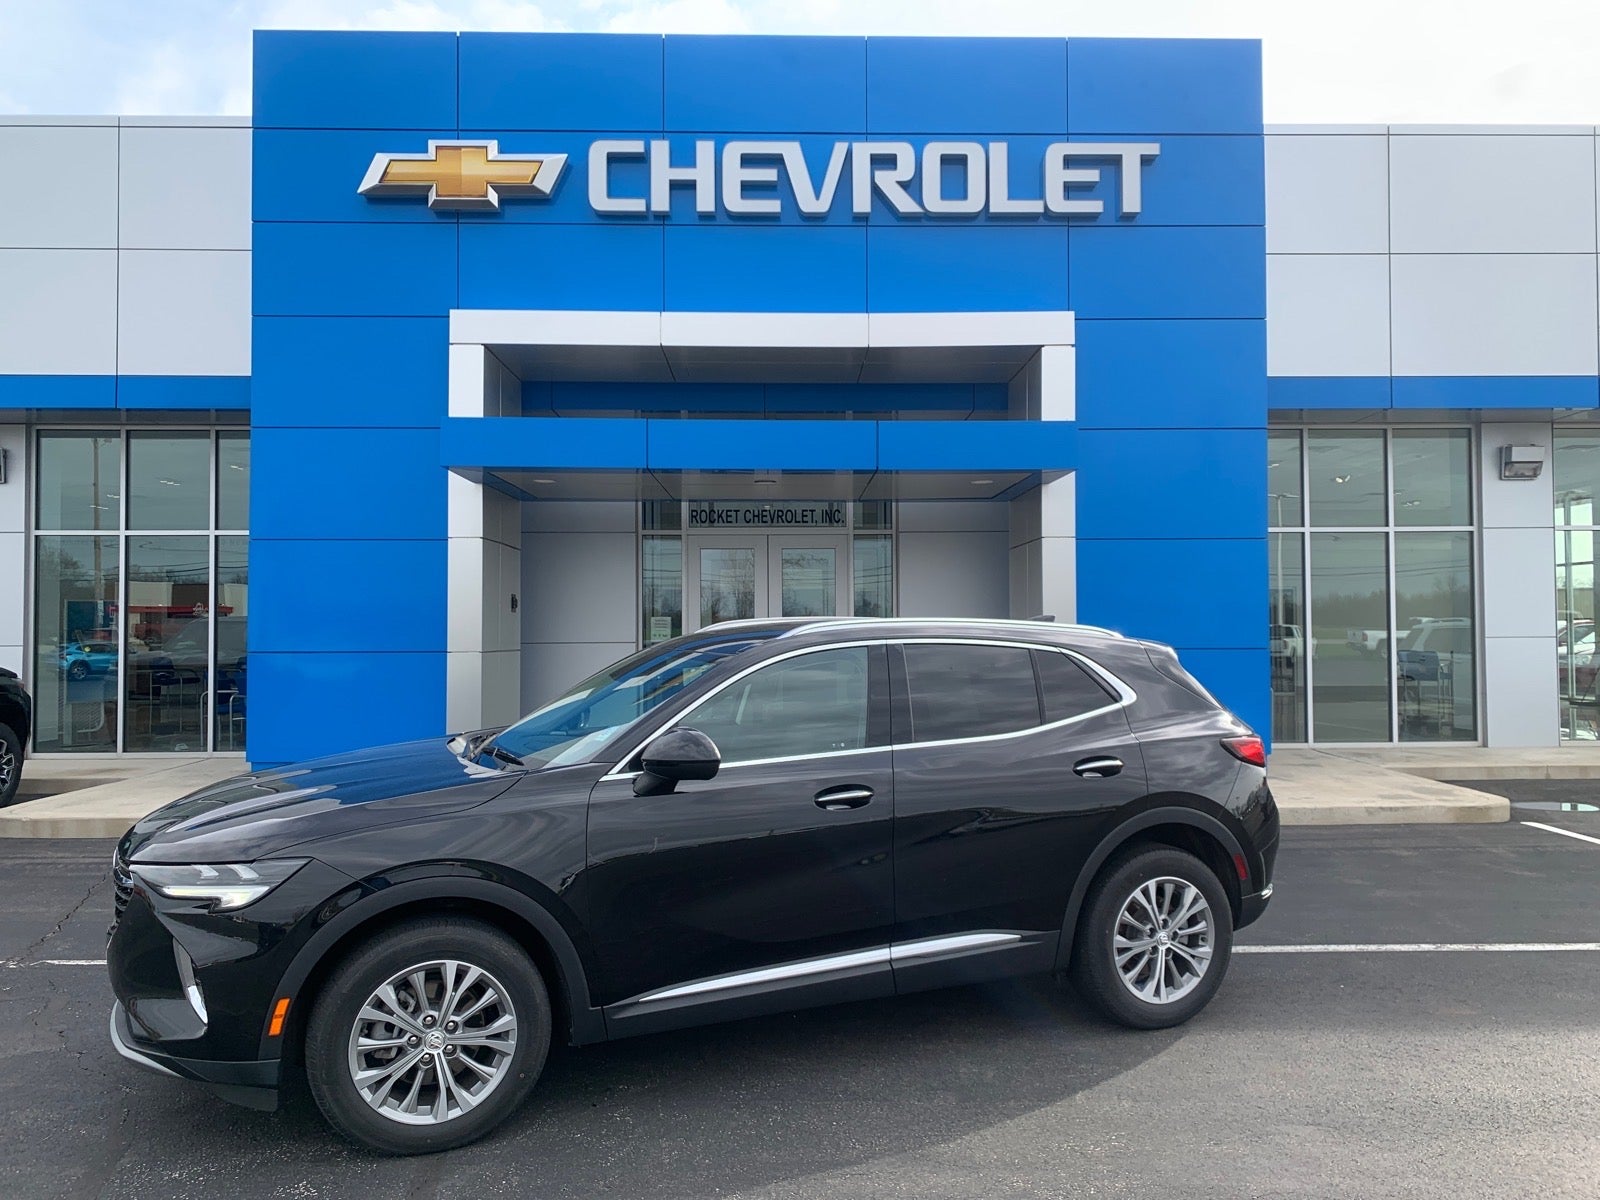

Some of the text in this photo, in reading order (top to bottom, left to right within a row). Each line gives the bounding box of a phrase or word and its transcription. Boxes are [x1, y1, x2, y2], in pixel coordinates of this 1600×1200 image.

[588, 139, 1161, 216] CHEVROLET
[690, 509, 845, 526] ROCKET CHEVROLET, INC.
